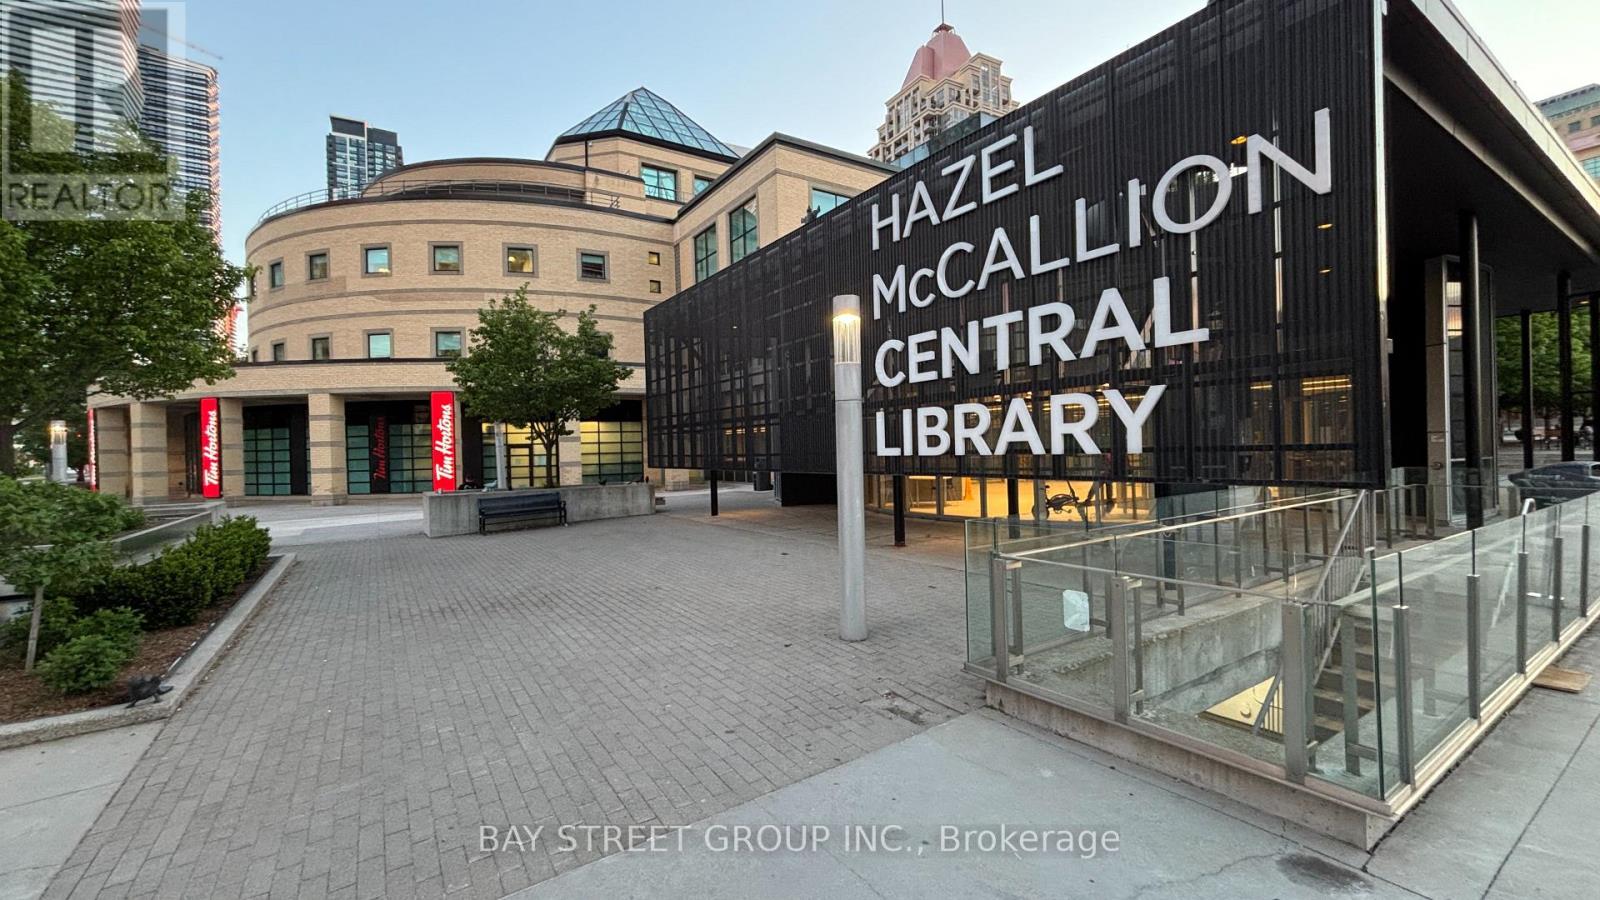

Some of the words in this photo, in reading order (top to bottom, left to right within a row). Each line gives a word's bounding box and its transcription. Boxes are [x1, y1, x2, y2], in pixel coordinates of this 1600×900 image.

[871, 125, 1064, 251] HAZEL
[872, 107, 1332, 320] McCALLION
[874, 276, 1210, 388] CENTRAL
[203, 409, 219, 461] Hortons
[434, 403, 454, 456] Hortons
[875, 384, 1168, 457] LIBRARY
[204, 461, 220, 487] Tim
[436, 456, 455, 481] Tim
